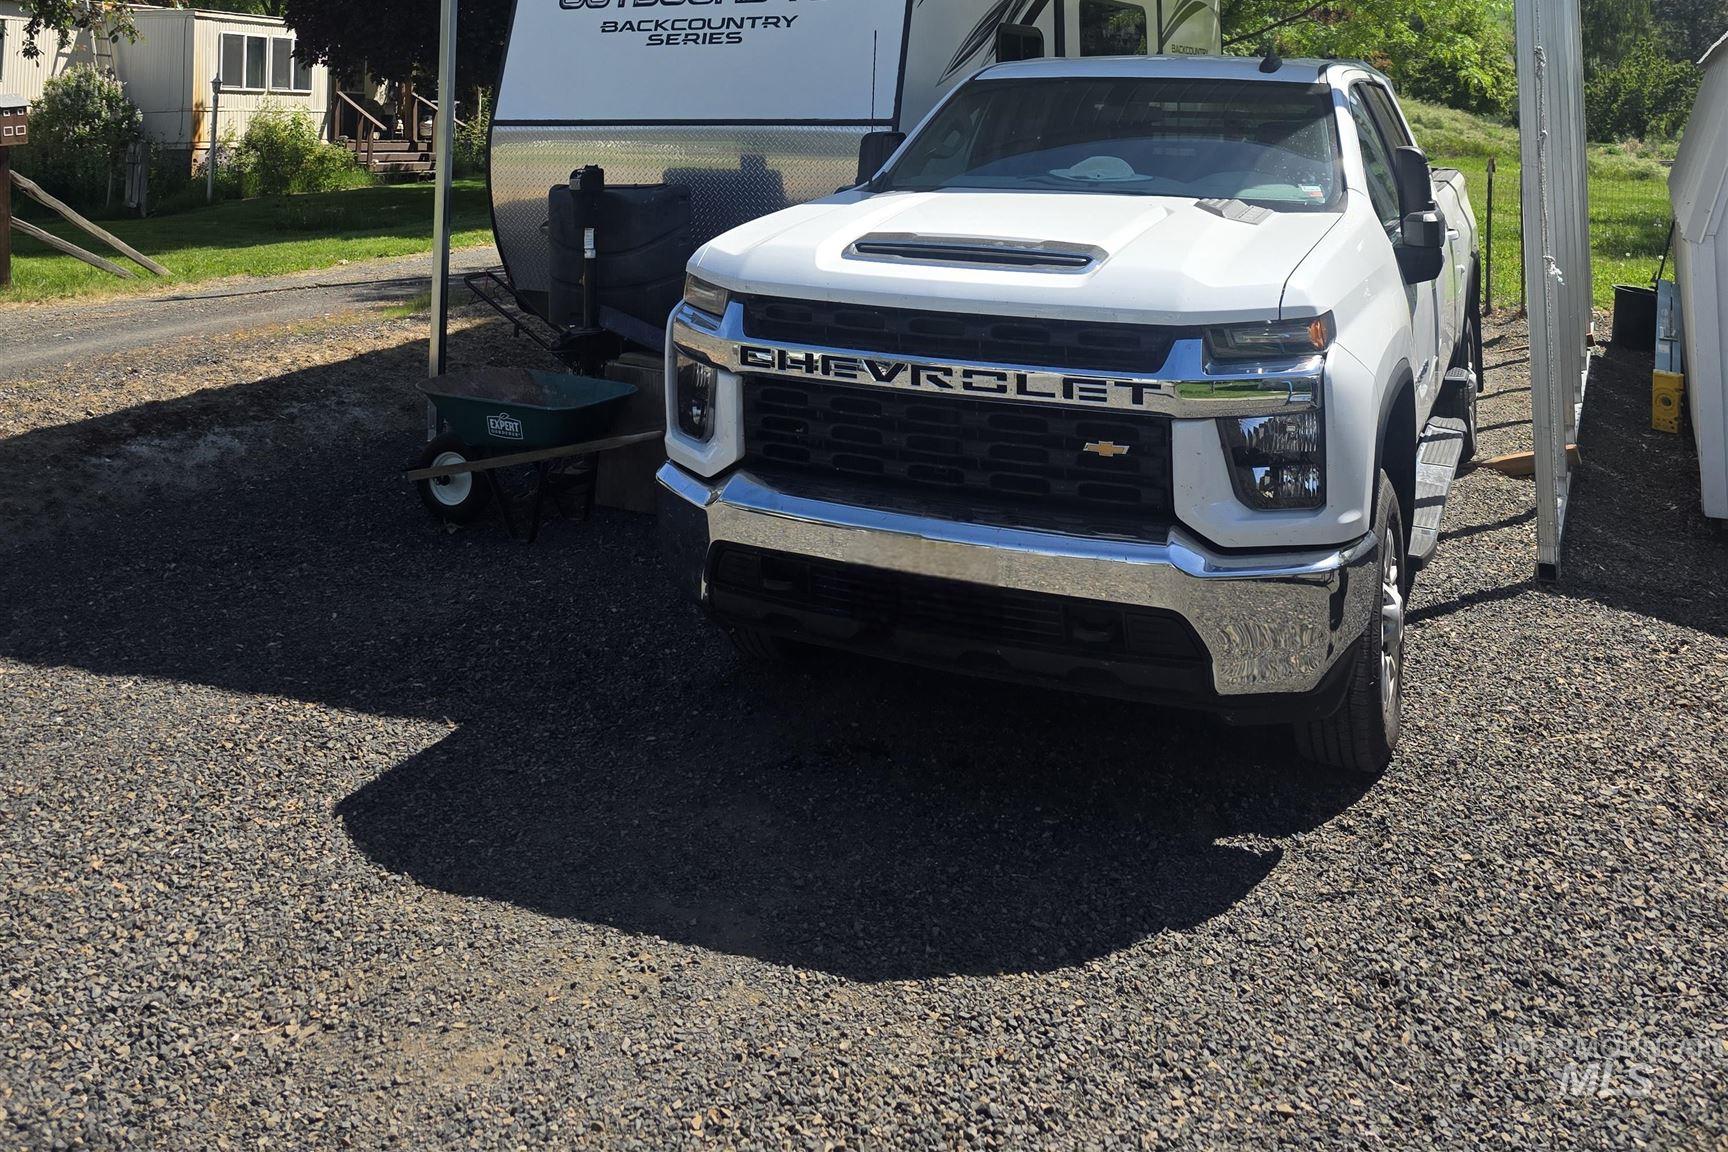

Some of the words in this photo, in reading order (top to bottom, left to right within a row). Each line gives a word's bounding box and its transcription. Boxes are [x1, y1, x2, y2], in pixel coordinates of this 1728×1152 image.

[600, 14, 799, 33] BACKCOUNTRY
[646, 31, 743, 46] SERIES
[740, 345, 1161, 405] CHEVROLET
[489, 419, 519, 432] EXPERT
